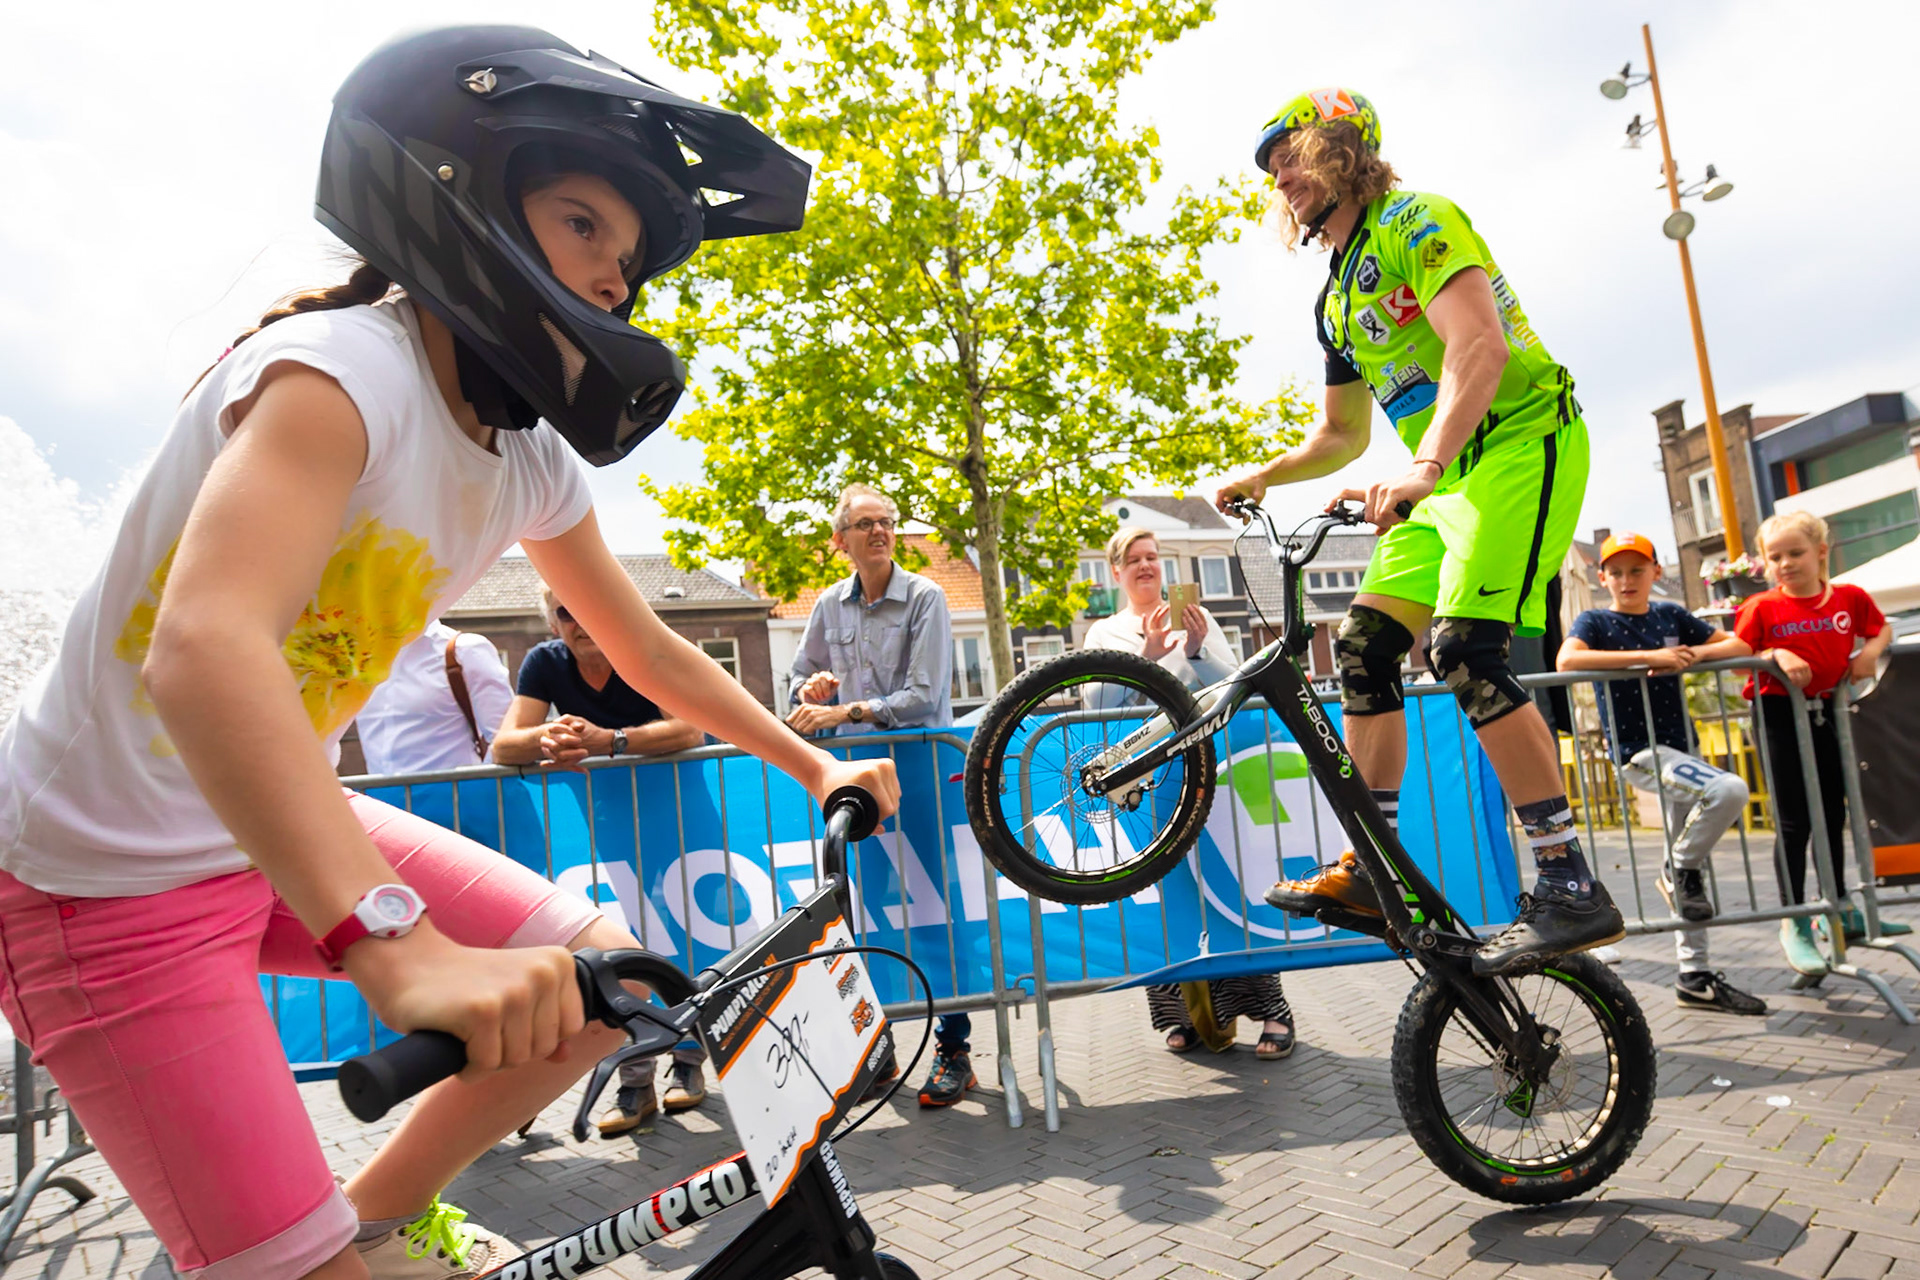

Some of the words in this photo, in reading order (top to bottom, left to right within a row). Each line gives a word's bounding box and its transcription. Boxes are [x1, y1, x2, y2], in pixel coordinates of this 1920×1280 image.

[1358, 310, 1374, 324] LIFE
[1772, 617, 1834, 638] CIRCUS
[1123, 726, 1151, 749] BONZ
[1296, 683, 1339, 753] TABOO
[981, 773, 994, 828] MONTY
[821, 1139, 858, 1219] REPUMPED
